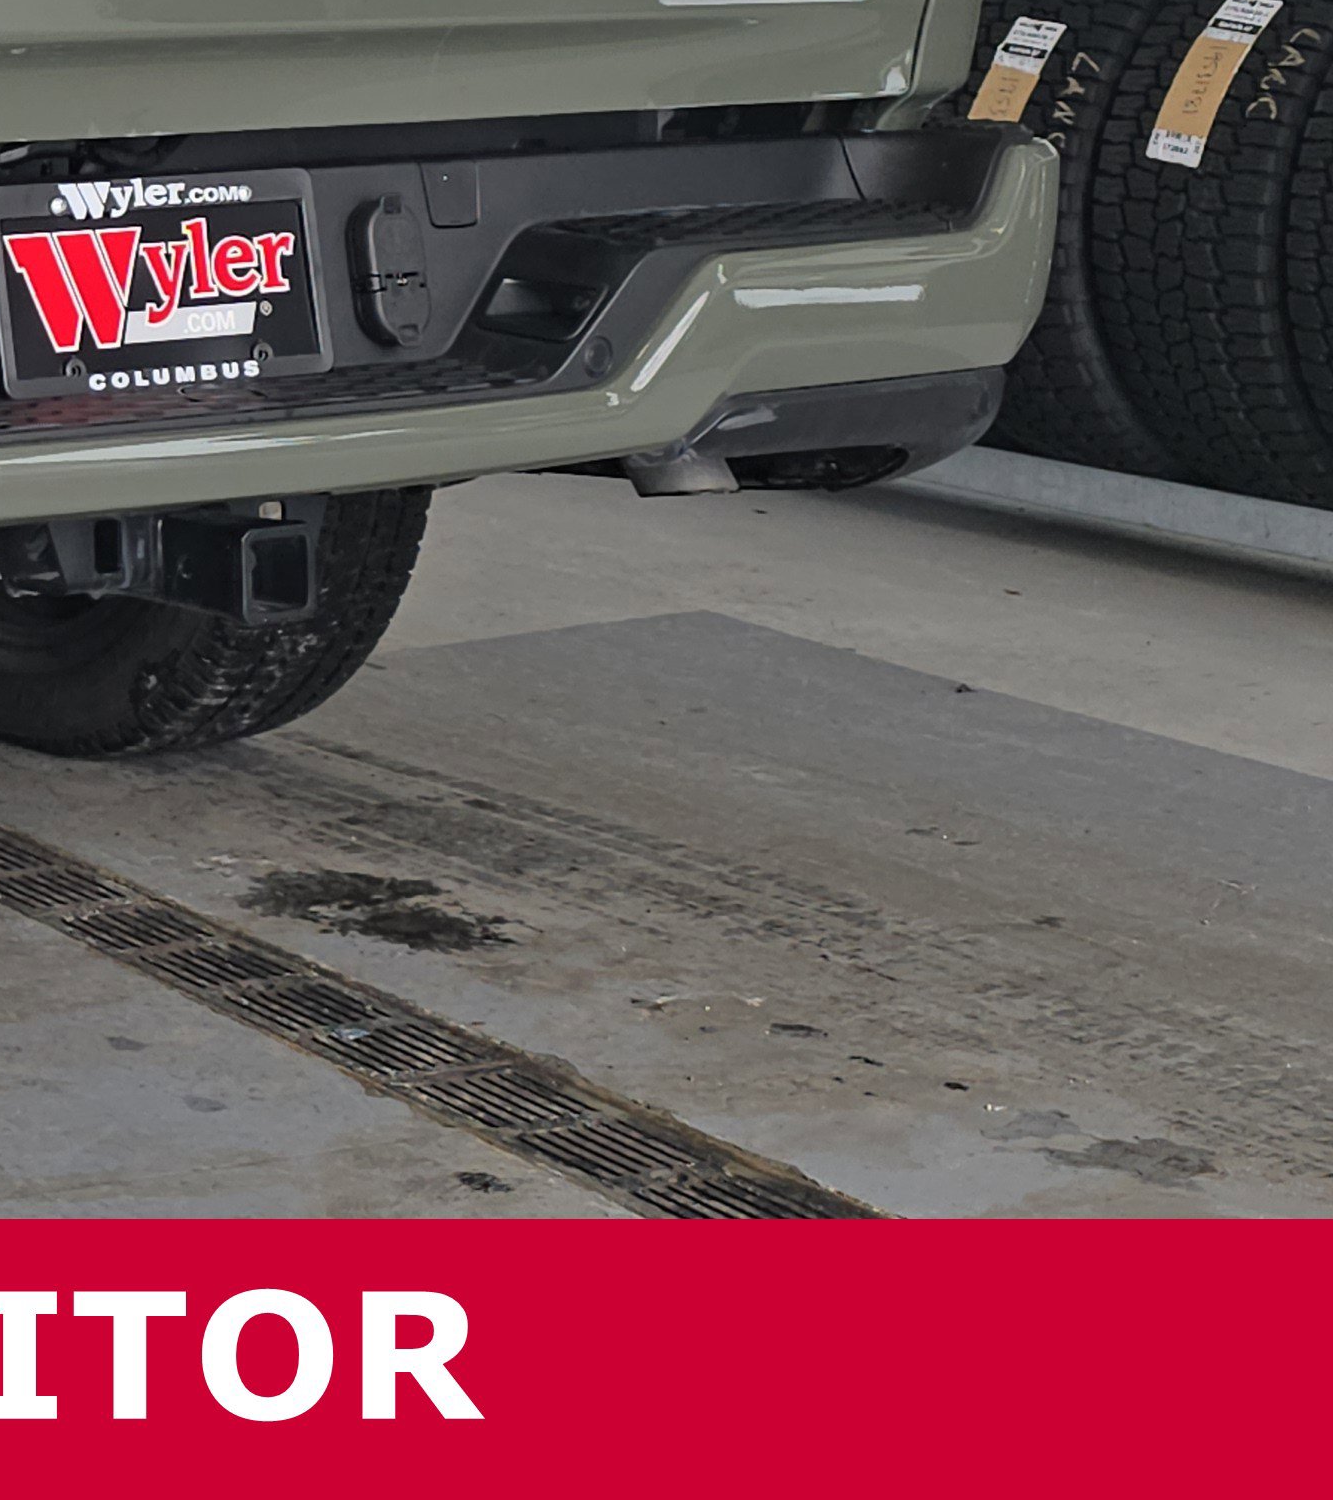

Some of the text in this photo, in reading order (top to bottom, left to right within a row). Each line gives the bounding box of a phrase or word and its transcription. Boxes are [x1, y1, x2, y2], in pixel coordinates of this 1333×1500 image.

[2, 216, 296, 355] Wyler
[183, 308, 237, 336] .COM
[88, 359, 261, 392] COLUMBUS
